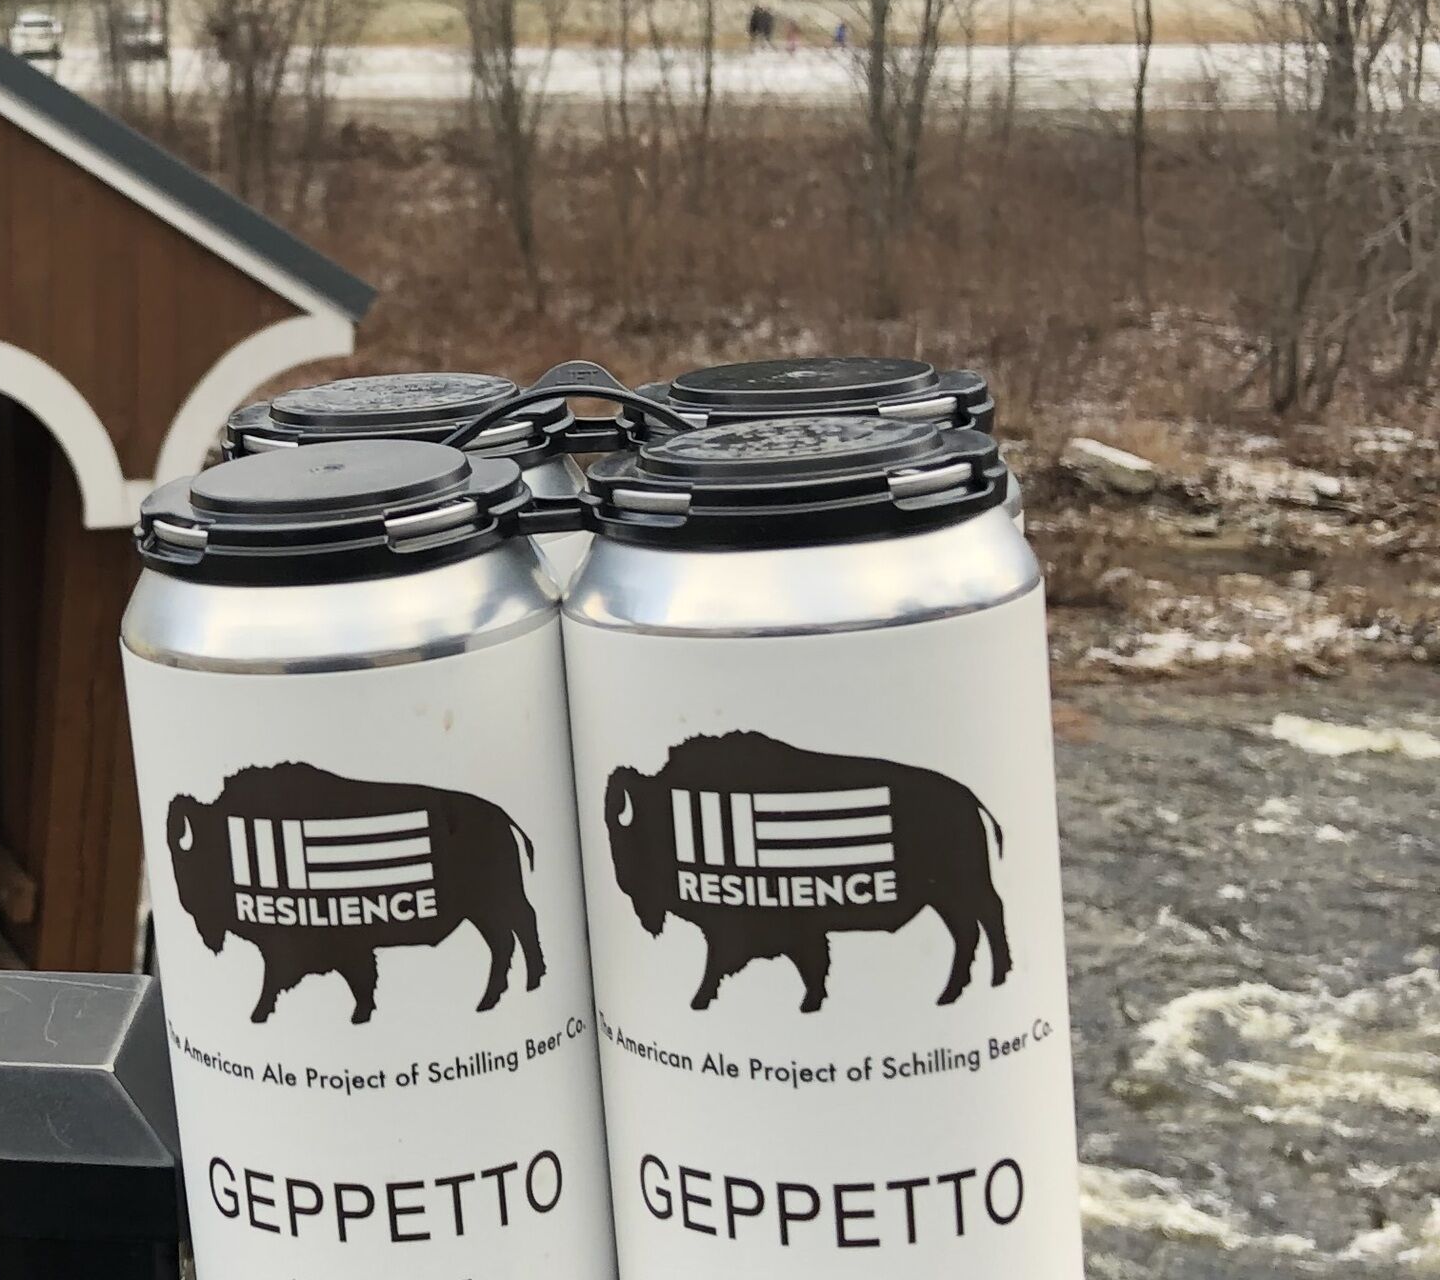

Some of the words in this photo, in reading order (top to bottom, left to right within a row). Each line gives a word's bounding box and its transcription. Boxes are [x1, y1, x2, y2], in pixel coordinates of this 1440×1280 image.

[235, 888, 438, 927] RESILIENCE
[677, 870, 898, 908] RESILIENCE
[184, 1036, 254, 1080] American
[262, 1064, 297, 1088] Ale
[306, 1069, 386, 1096] Project
[396, 1064, 420, 1088] of
[428, 1049, 518, 1081] Schilling
[525, 1029, 563, 1060] Beer
[565, 1017, 587, 1039] Co.
[616, 1026, 693, 1071] American
[701, 1054, 739, 1079] Ale
[749, 1059, 836, 1088] Project
[846, 1055, 872, 1082] of
[882, 1045, 980, 1079] Schilling
[989, 1034, 1027, 1061] Beer
[208, 1149, 563, 1243] GEPPETTO
[639, 1154, 1025, 1249] GEPPETTO
